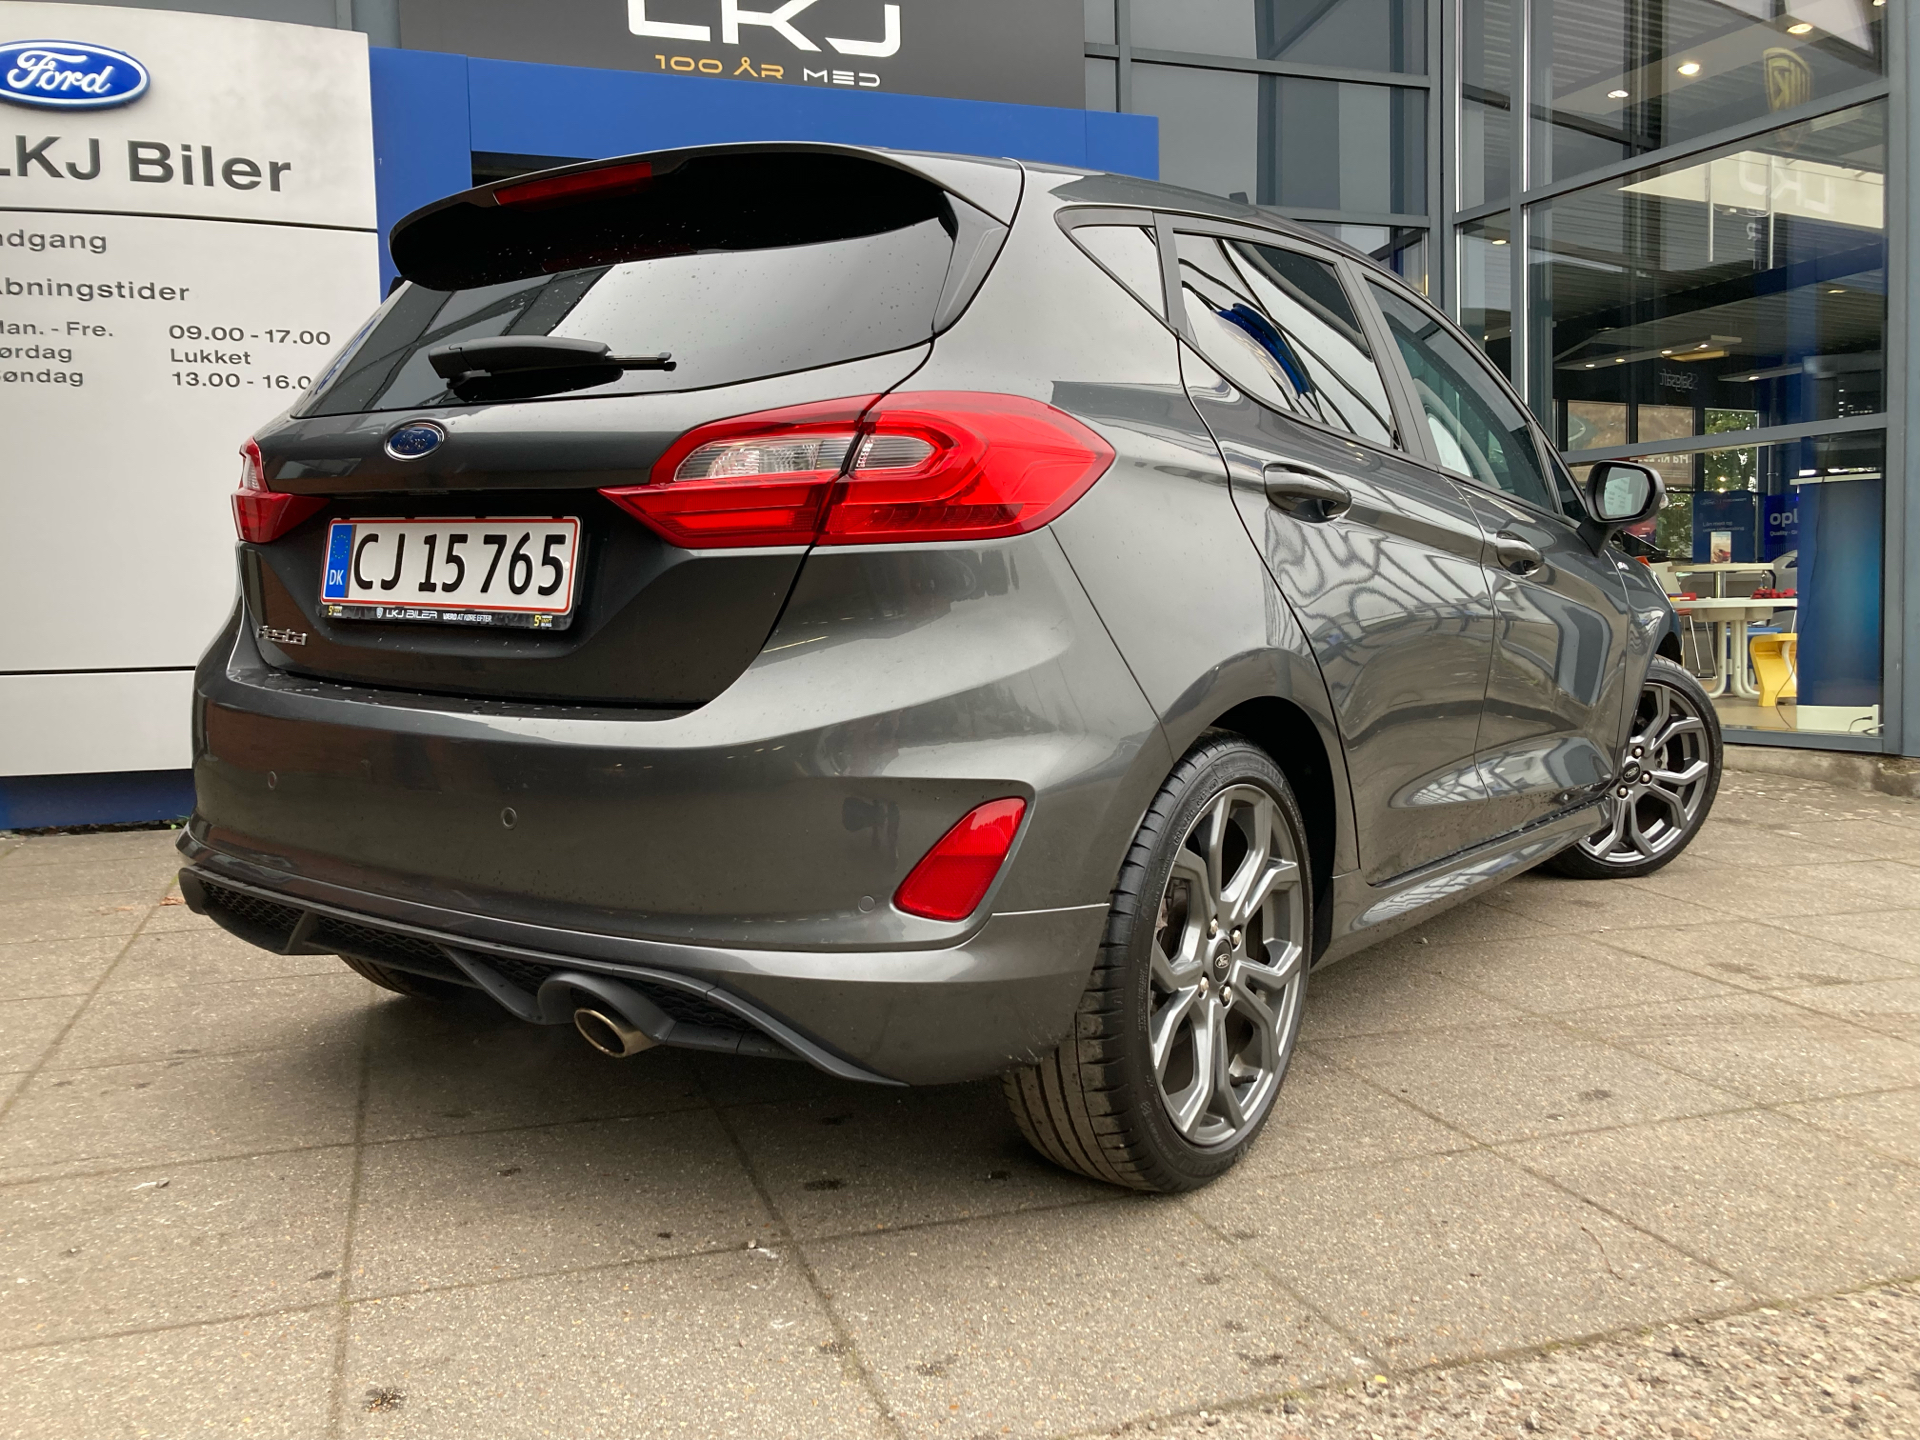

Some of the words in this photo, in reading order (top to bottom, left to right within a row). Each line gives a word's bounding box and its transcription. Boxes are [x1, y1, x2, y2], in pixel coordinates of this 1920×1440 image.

[628, 0, 901, 58] LKJ
[7, 50, 115, 93] Ford
[655, 54, 723, 74] 100
[733, 56, 784, 80] ÅR
[803, 68, 881, 87] MED
[127, 140, 292, 192] Biler
[0, 228, 107, 254] dgang
[0, 276, 190, 302] bningstider
[66, 321, 114, 337] Fre.
[168, 324, 245, 342] 09.00
[264, 329, 331, 346] 17.00
[170, 348, 252, 365] Lukket
[0, 368, 84, 388] øndag
[172, 371, 241, 388] 13.00
[262, 374, 312, 390] 16.0
[353, 532, 406, 591] CJ
[418, 532, 469, 593] 15
[480, 531, 567, 596] 765
[328, 568, 344, 586] DK
[386, 609, 404, 618] LKJ
[406, 609, 438, 619] BILER
